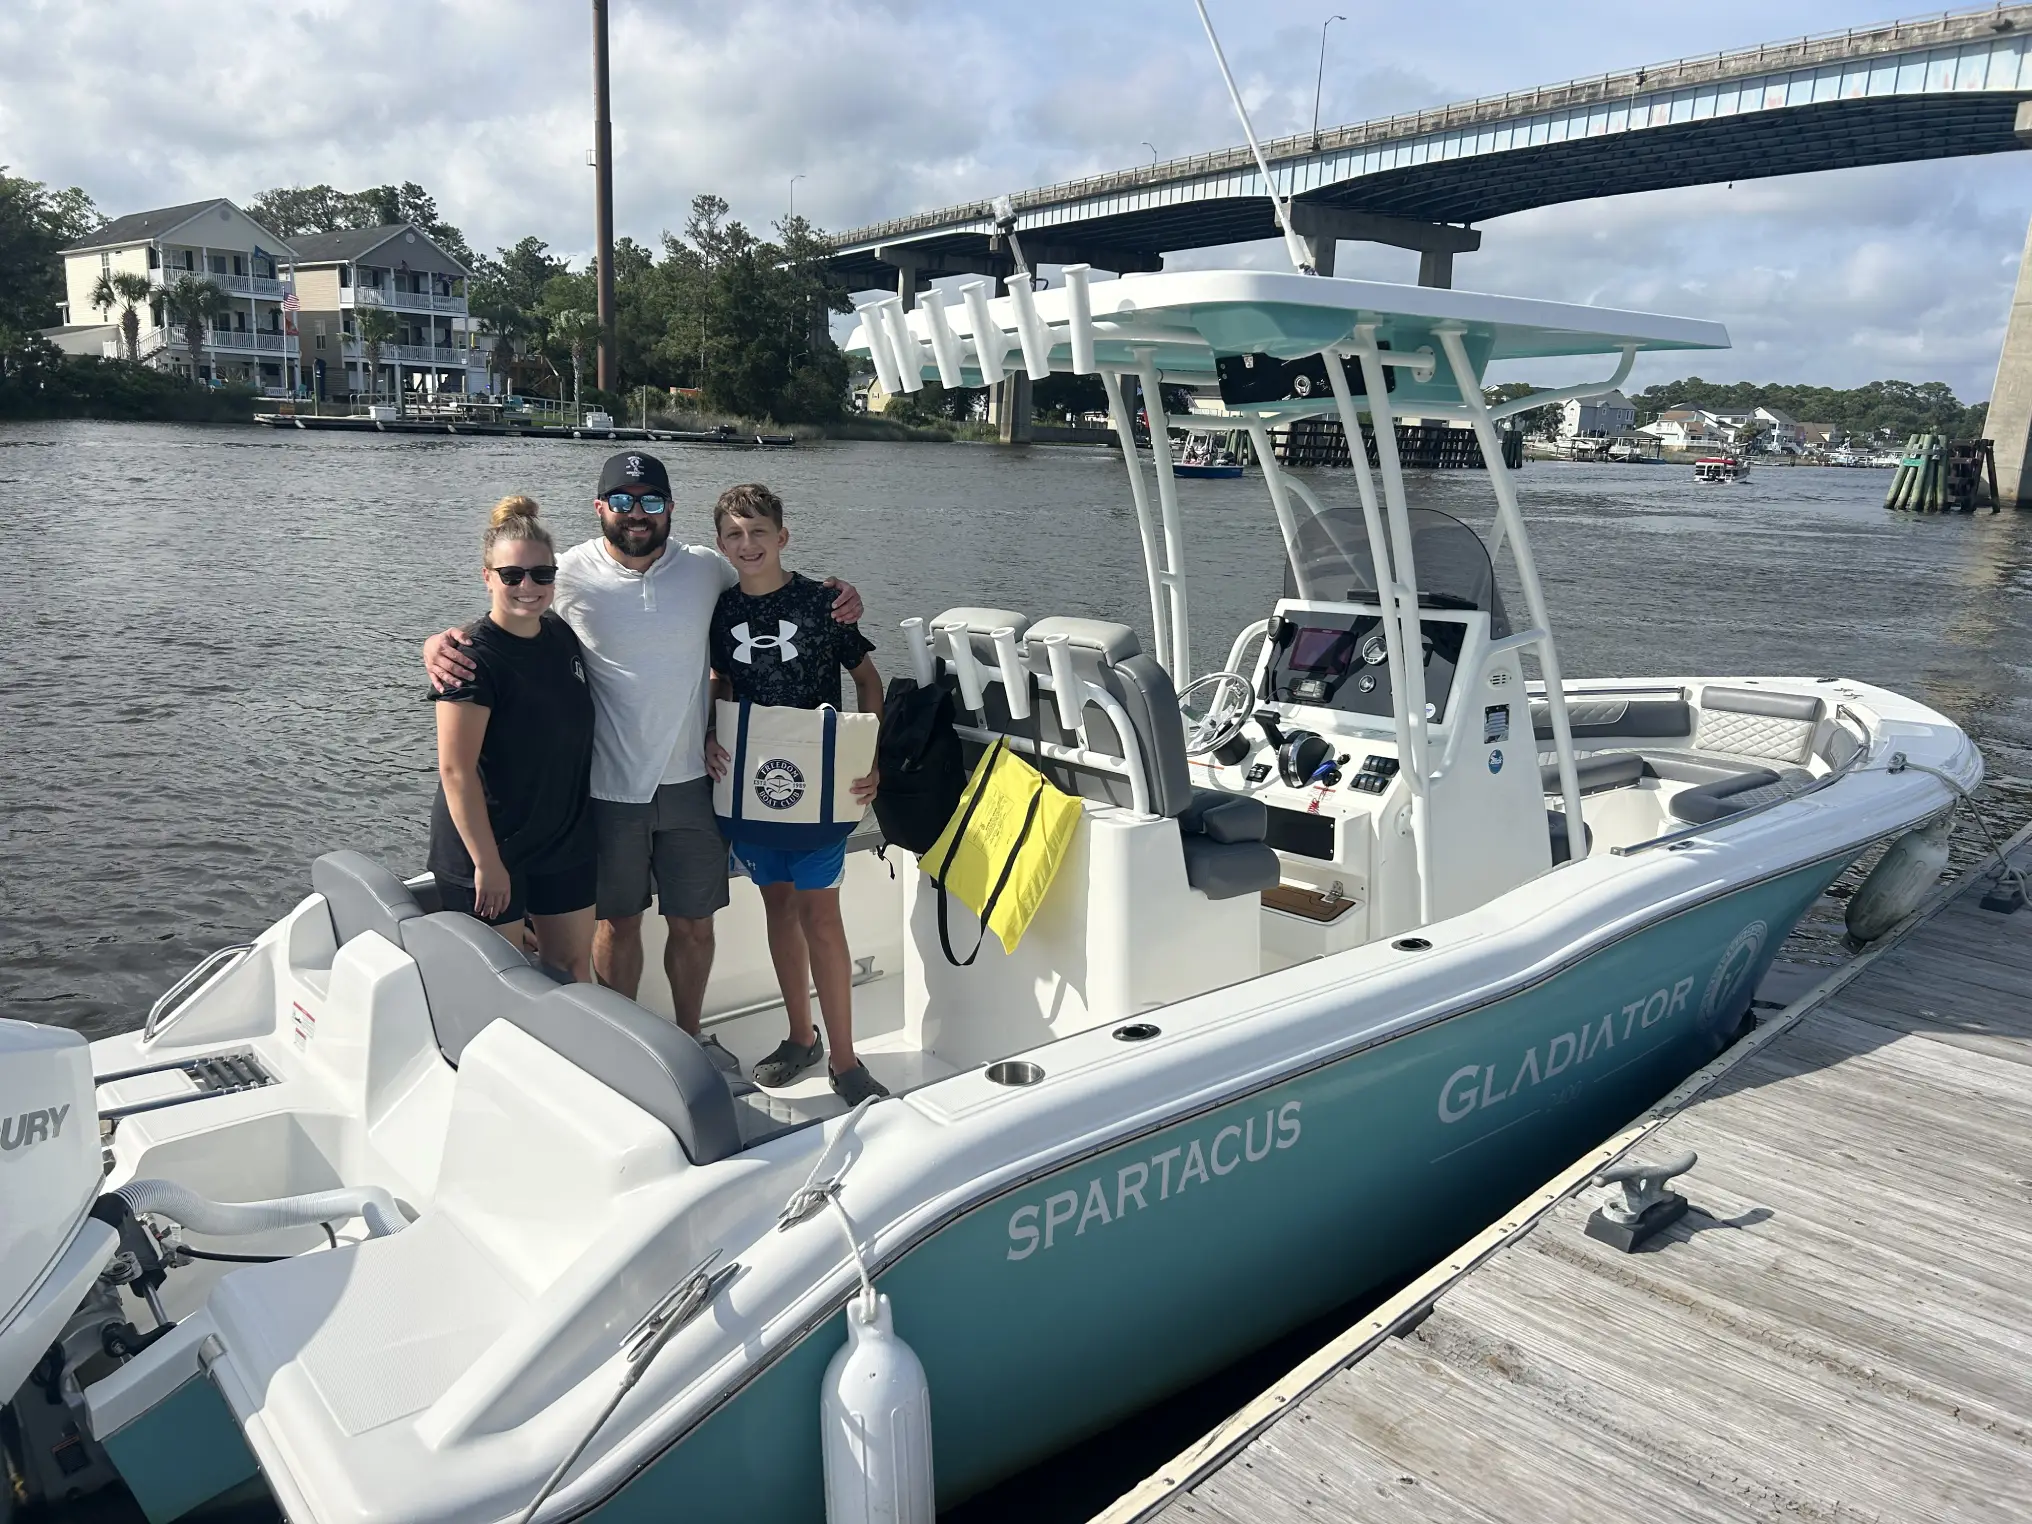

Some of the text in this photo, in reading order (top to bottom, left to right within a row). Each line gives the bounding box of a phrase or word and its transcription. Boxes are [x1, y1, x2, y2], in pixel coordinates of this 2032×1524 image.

[759, 790, 800, 807] BOAT CLUB
[761, 761, 799, 778] FREEDOM
[1437, 975, 1695, 1124] GLADIATOR
[1006, 1100, 1304, 1262] SPARTACUS
